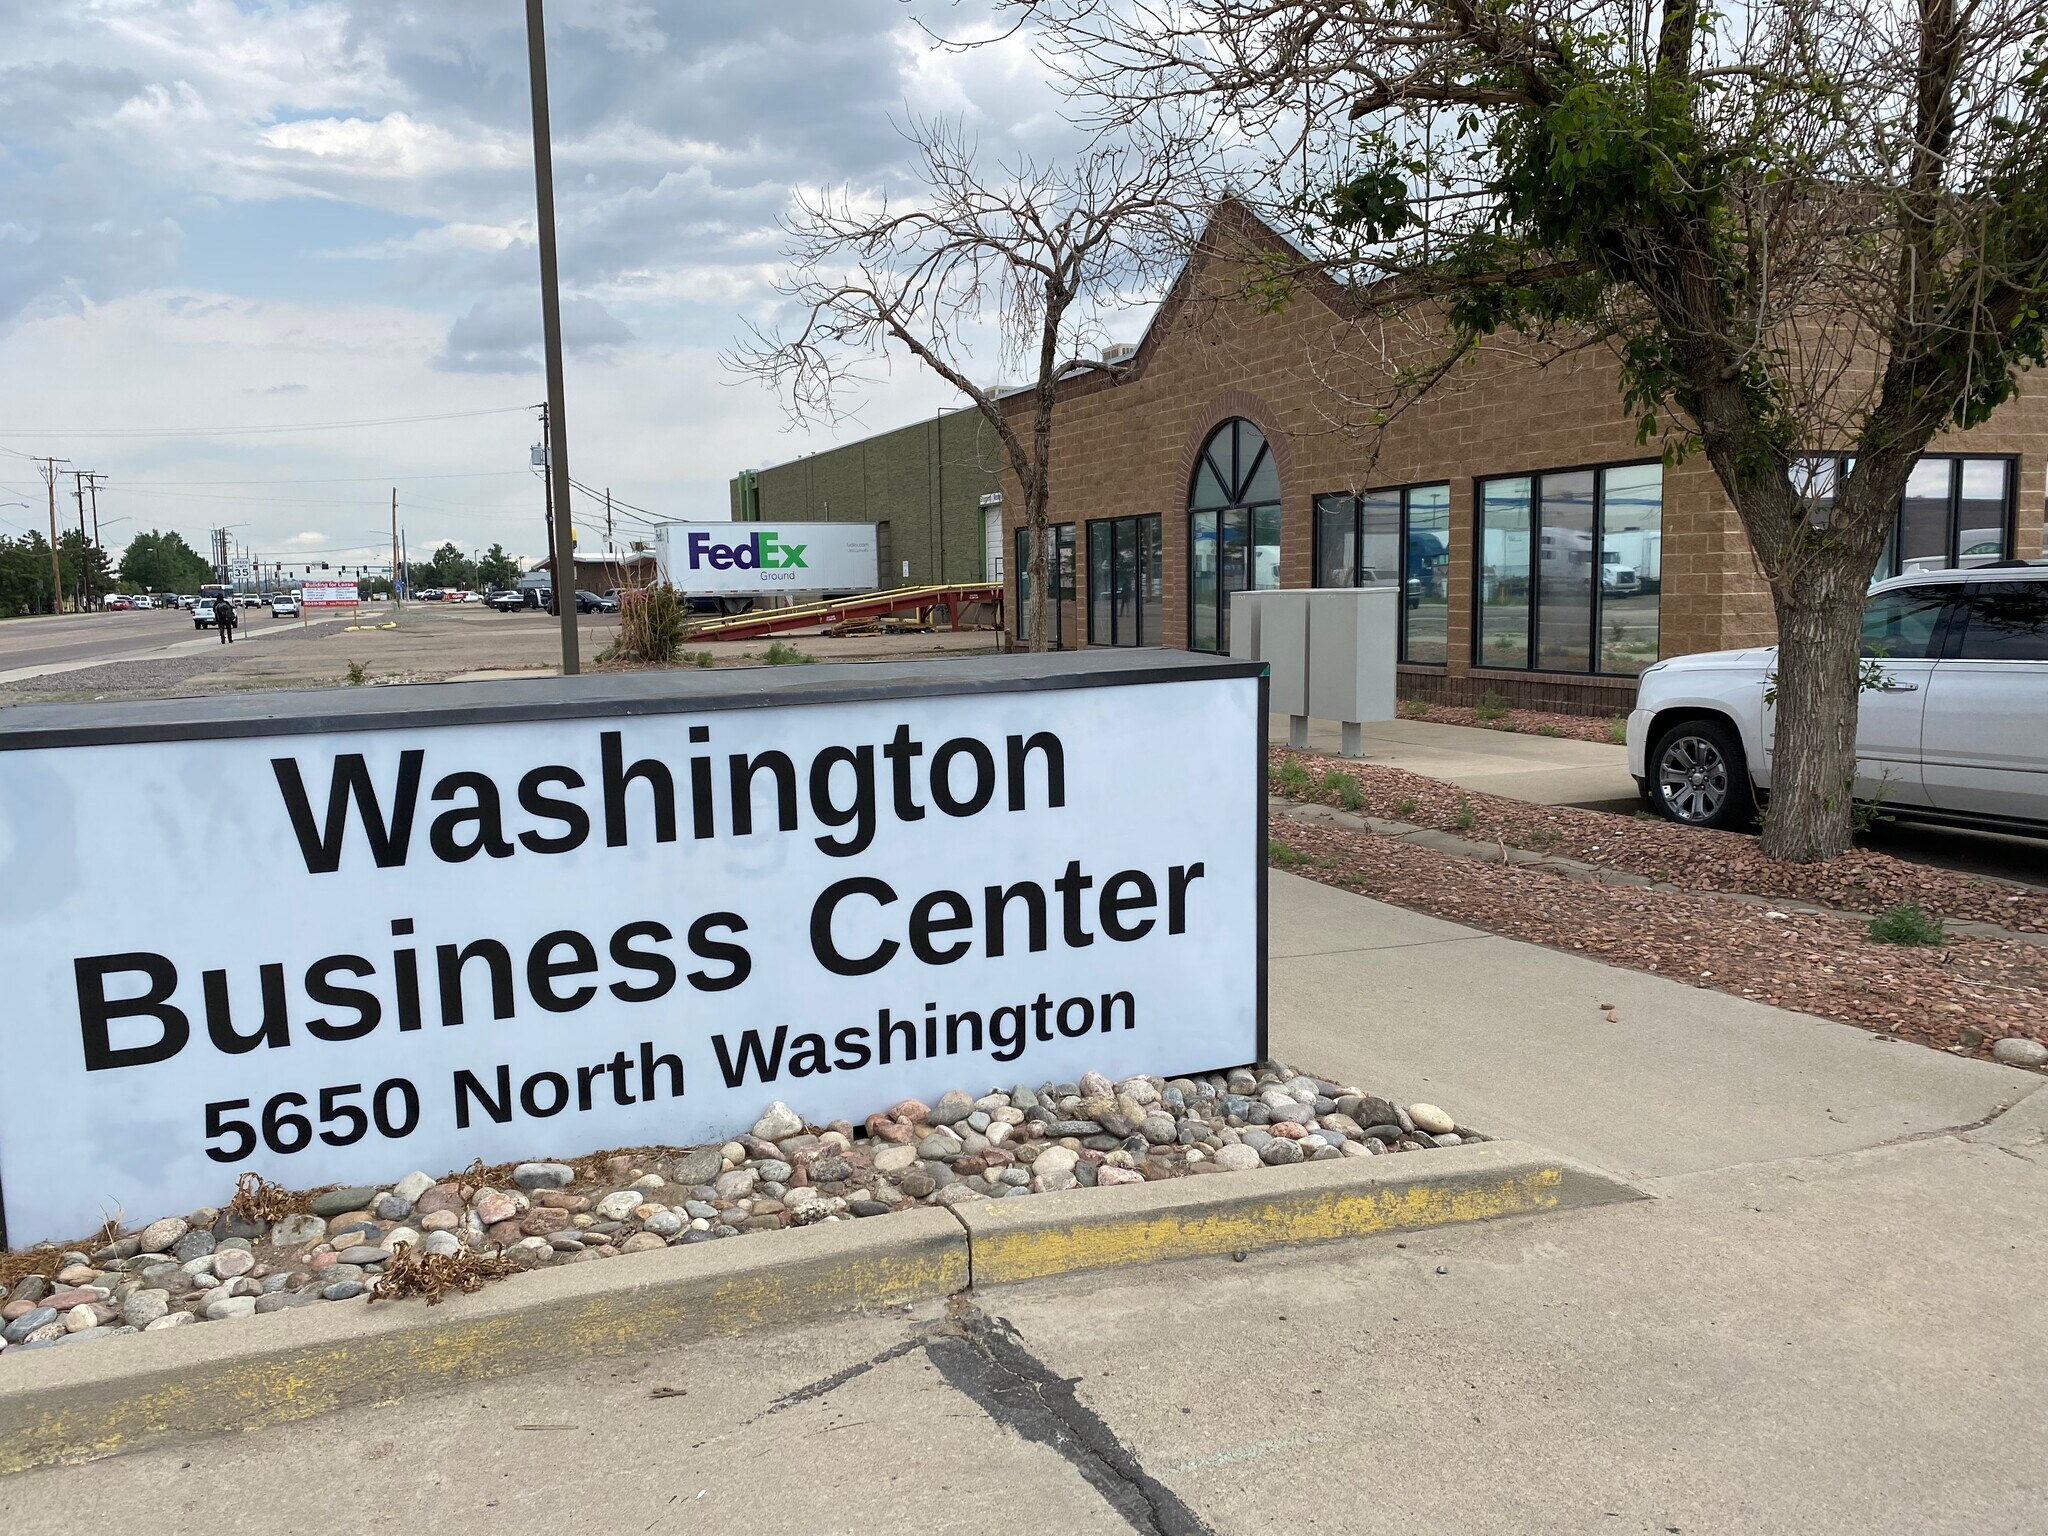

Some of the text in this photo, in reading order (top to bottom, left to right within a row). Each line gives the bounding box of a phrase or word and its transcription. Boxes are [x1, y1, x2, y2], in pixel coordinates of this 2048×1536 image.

[235, 568, 249, 577] 35
[688, 532, 809, 570] FedEx
[760, 571, 795, 581] Ground
[271, 724, 1066, 875] Washington
[74, 861, 1205, 1072] Business Center
[205, 991, 1135, 1163] 5650 North Washington
